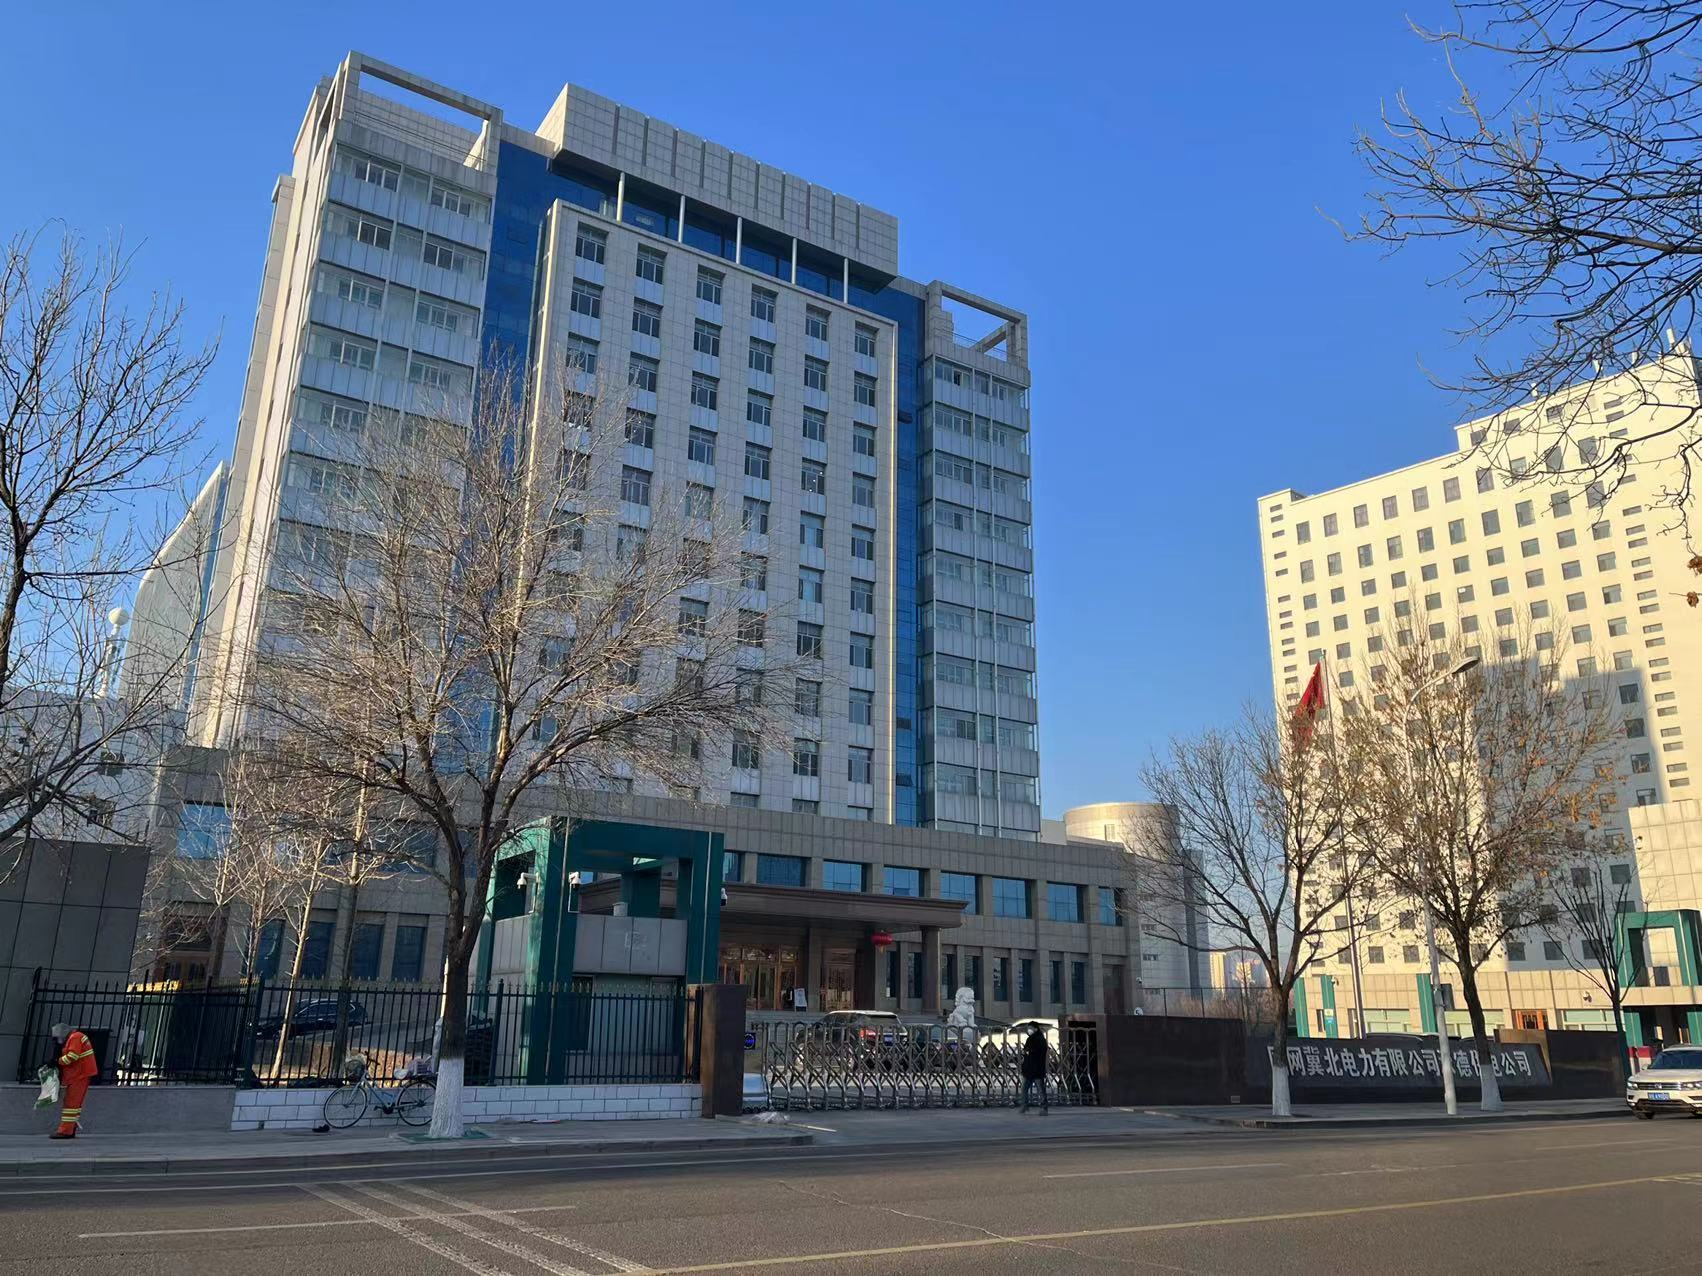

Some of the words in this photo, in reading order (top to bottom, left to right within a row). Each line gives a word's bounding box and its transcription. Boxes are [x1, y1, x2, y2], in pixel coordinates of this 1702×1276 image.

[1267, 1046, 1531, 1077] 网冀北电力有限公司德电公司
